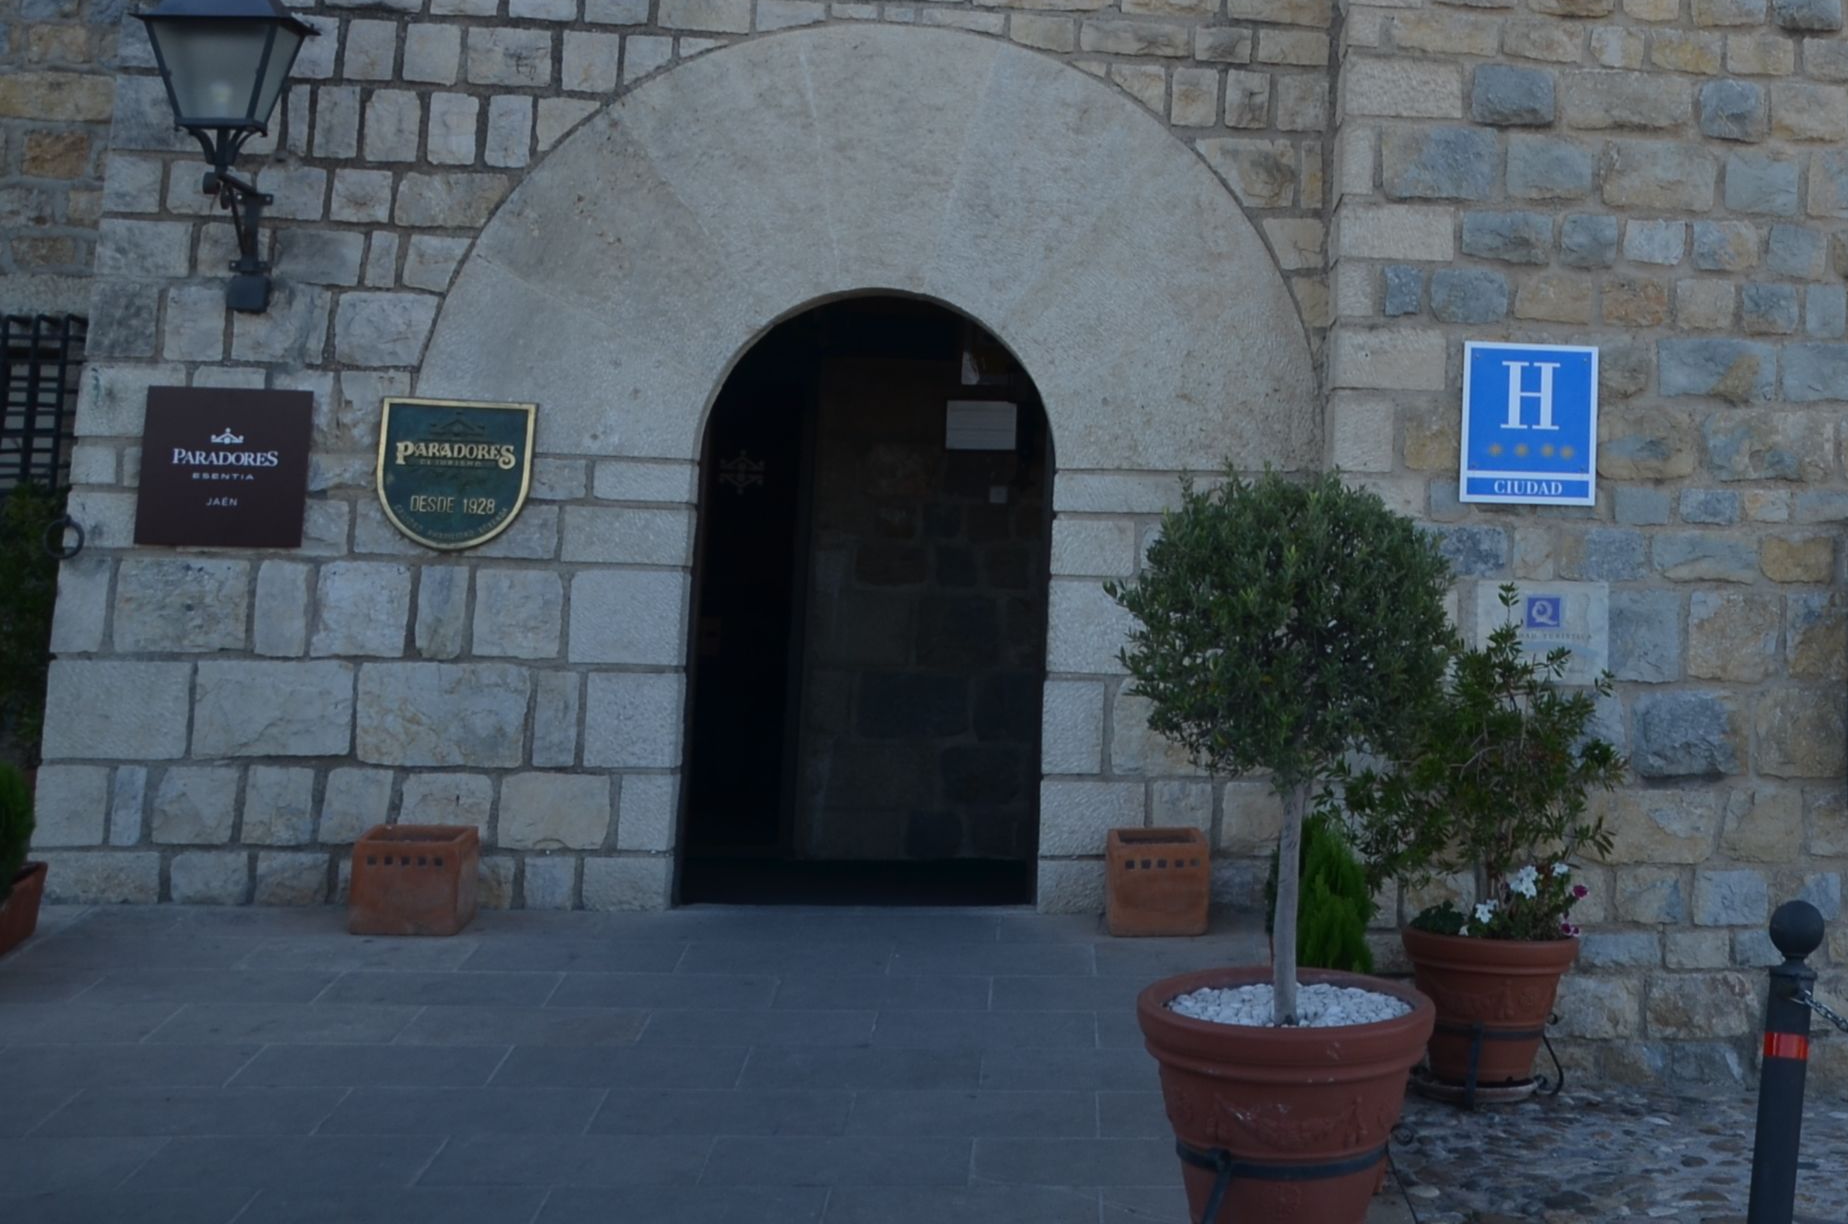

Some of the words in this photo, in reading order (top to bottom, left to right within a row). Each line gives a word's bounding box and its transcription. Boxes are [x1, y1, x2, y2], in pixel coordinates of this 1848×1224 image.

[1501, 359, 1561, 430] H
[172, 446, 279, 468] PARADORES
[395, 441, 516, 470] PARADORES
[191, 471, 255, 481] ESENTIA
[1493, 478, 1563, 497] CIUDAD
[205, 496, 239, 507] JAÉN
[409, 495, 455, 513] DESDE
[463, 497, 496, 515] 1928
